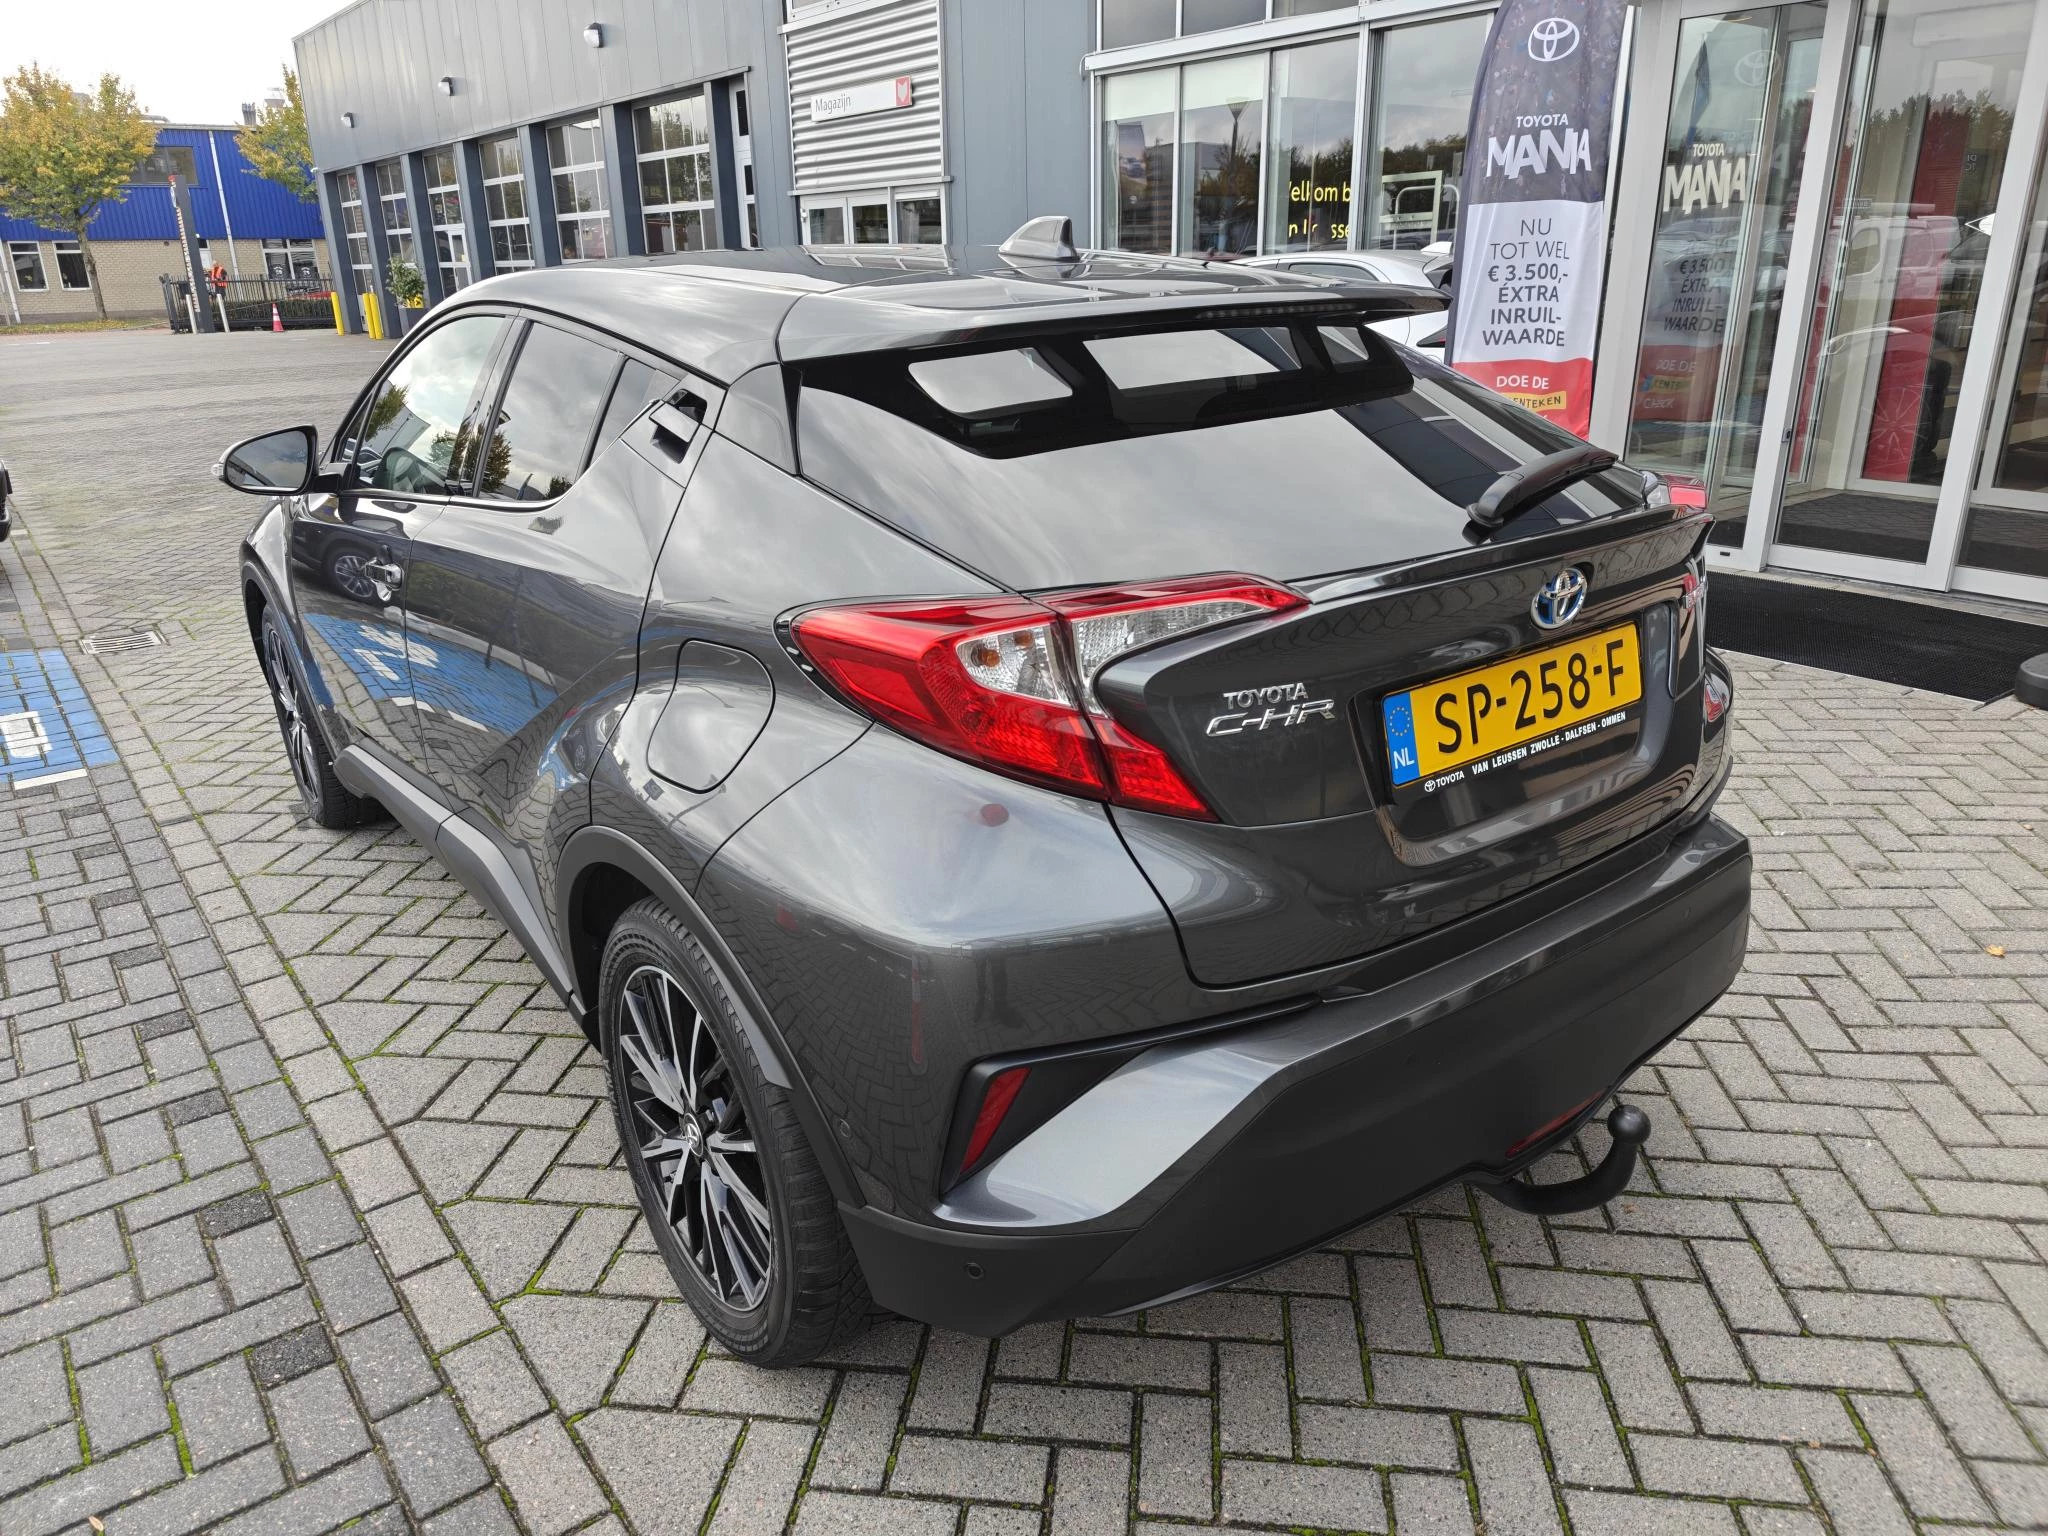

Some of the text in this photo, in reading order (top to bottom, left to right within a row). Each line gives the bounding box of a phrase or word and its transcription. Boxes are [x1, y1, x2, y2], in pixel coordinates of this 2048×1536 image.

[814, 93, 852, 115] Magazijn
[1515, 113, 1569, 129] TOYOTA
[1486, 127, 1593, 180] MANIA
[1692, 143, 1725, 157] TOYOTA
[1662, 157, 1747, 215] MANIA
[1520, 217, 1552, 237] NU
[1489, 240, 1570, 260] TOT WEL
[1498, 282, 1560, 304] ÉXTRA
[1490, 306, 1562, 325] INRUIL-
[1664, 316, 1726, 334] WAARDE
[1482, 328, 1565, 347] WAARDE
[1496, 374, 1550, 390] DOE DE
[1222, 682, 1309, 710] TOYOTA
[1433, 638, 1624, 754] SP-258-F
[1206, 698, 1336, 737] C-HR
[1393, 747, 1415, 770] NL
[1435, 771, 1465, 788] TOYOTA
[1471, 762, 1489, 776] VAN
[1492, 748, 1528, 768] LEUSSEN
[1530, 736, 1560, 754] ZWOLLE
[1565, 723, 1597, 741] DALFSEN
[1601, 711, 1627, 728] OMMEN
